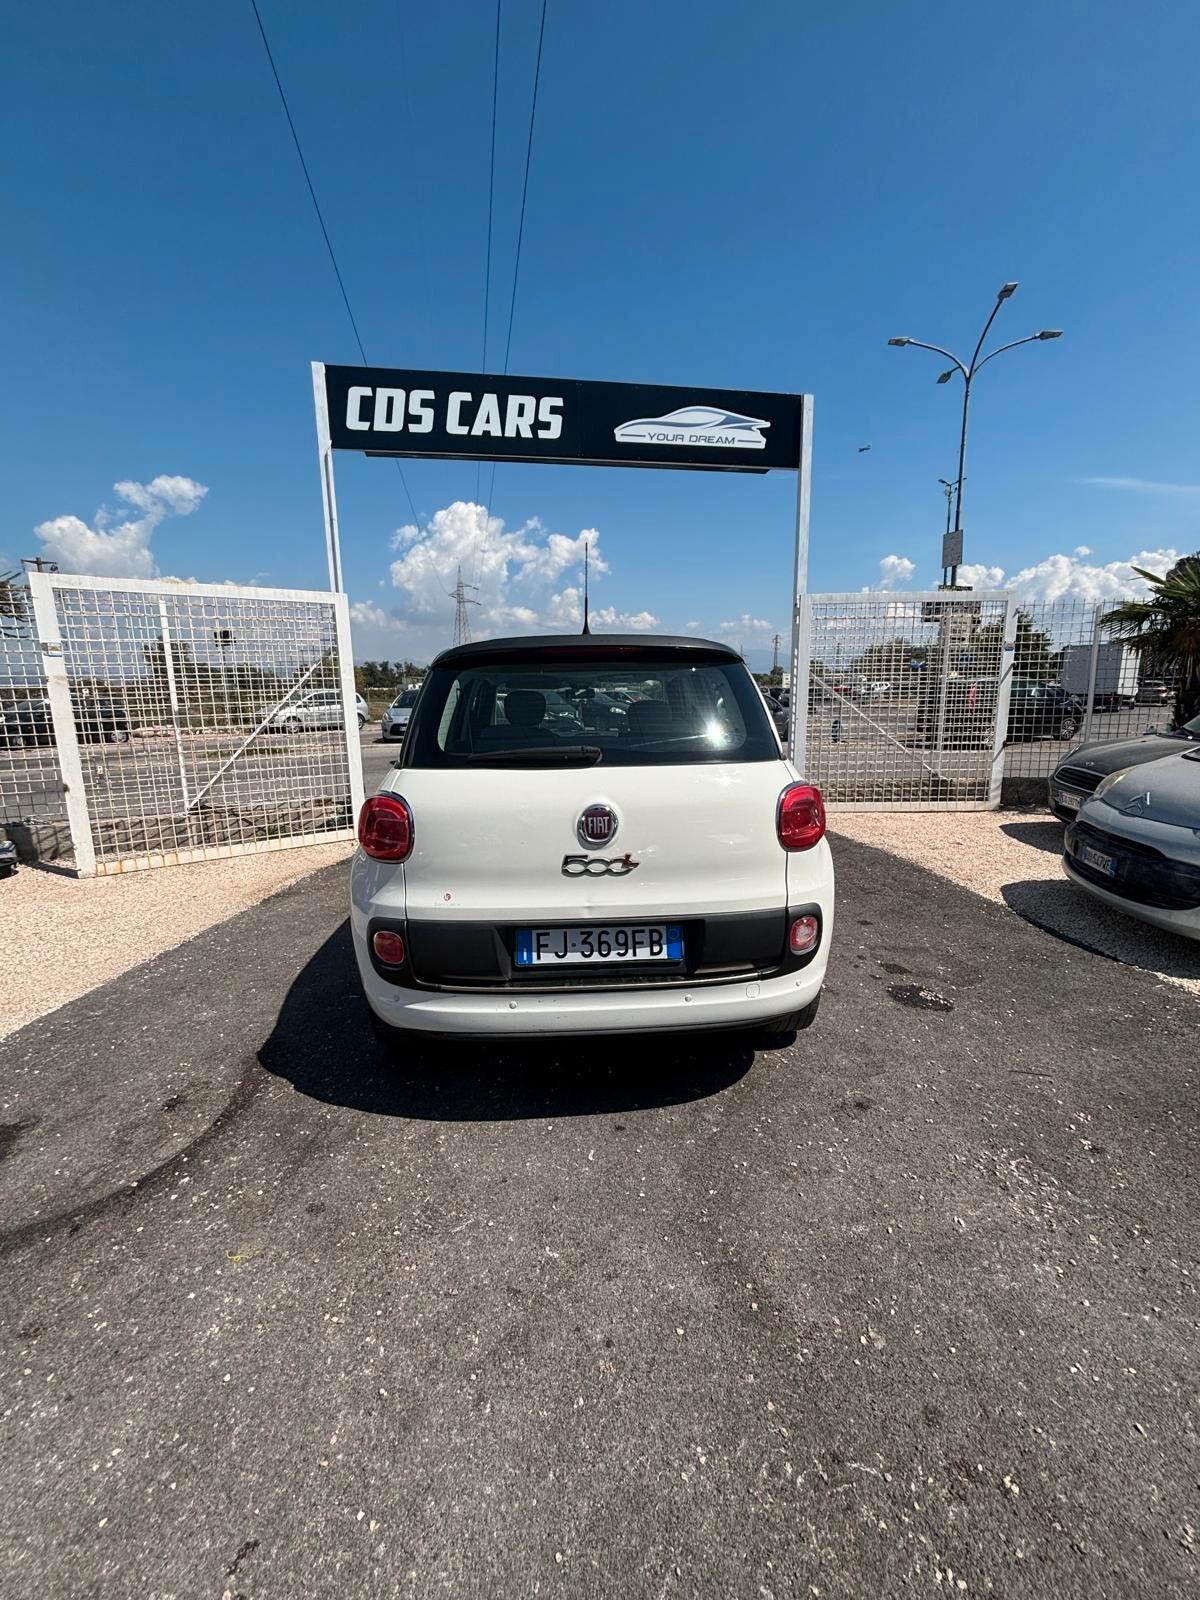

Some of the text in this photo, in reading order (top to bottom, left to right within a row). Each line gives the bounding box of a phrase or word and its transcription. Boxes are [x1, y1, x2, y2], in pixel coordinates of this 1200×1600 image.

[346, 386, 564, 440] CDS CARS
[648, 433, 735, 445] YOUR DREAM
[588, 817, 609, 834] FIAT
